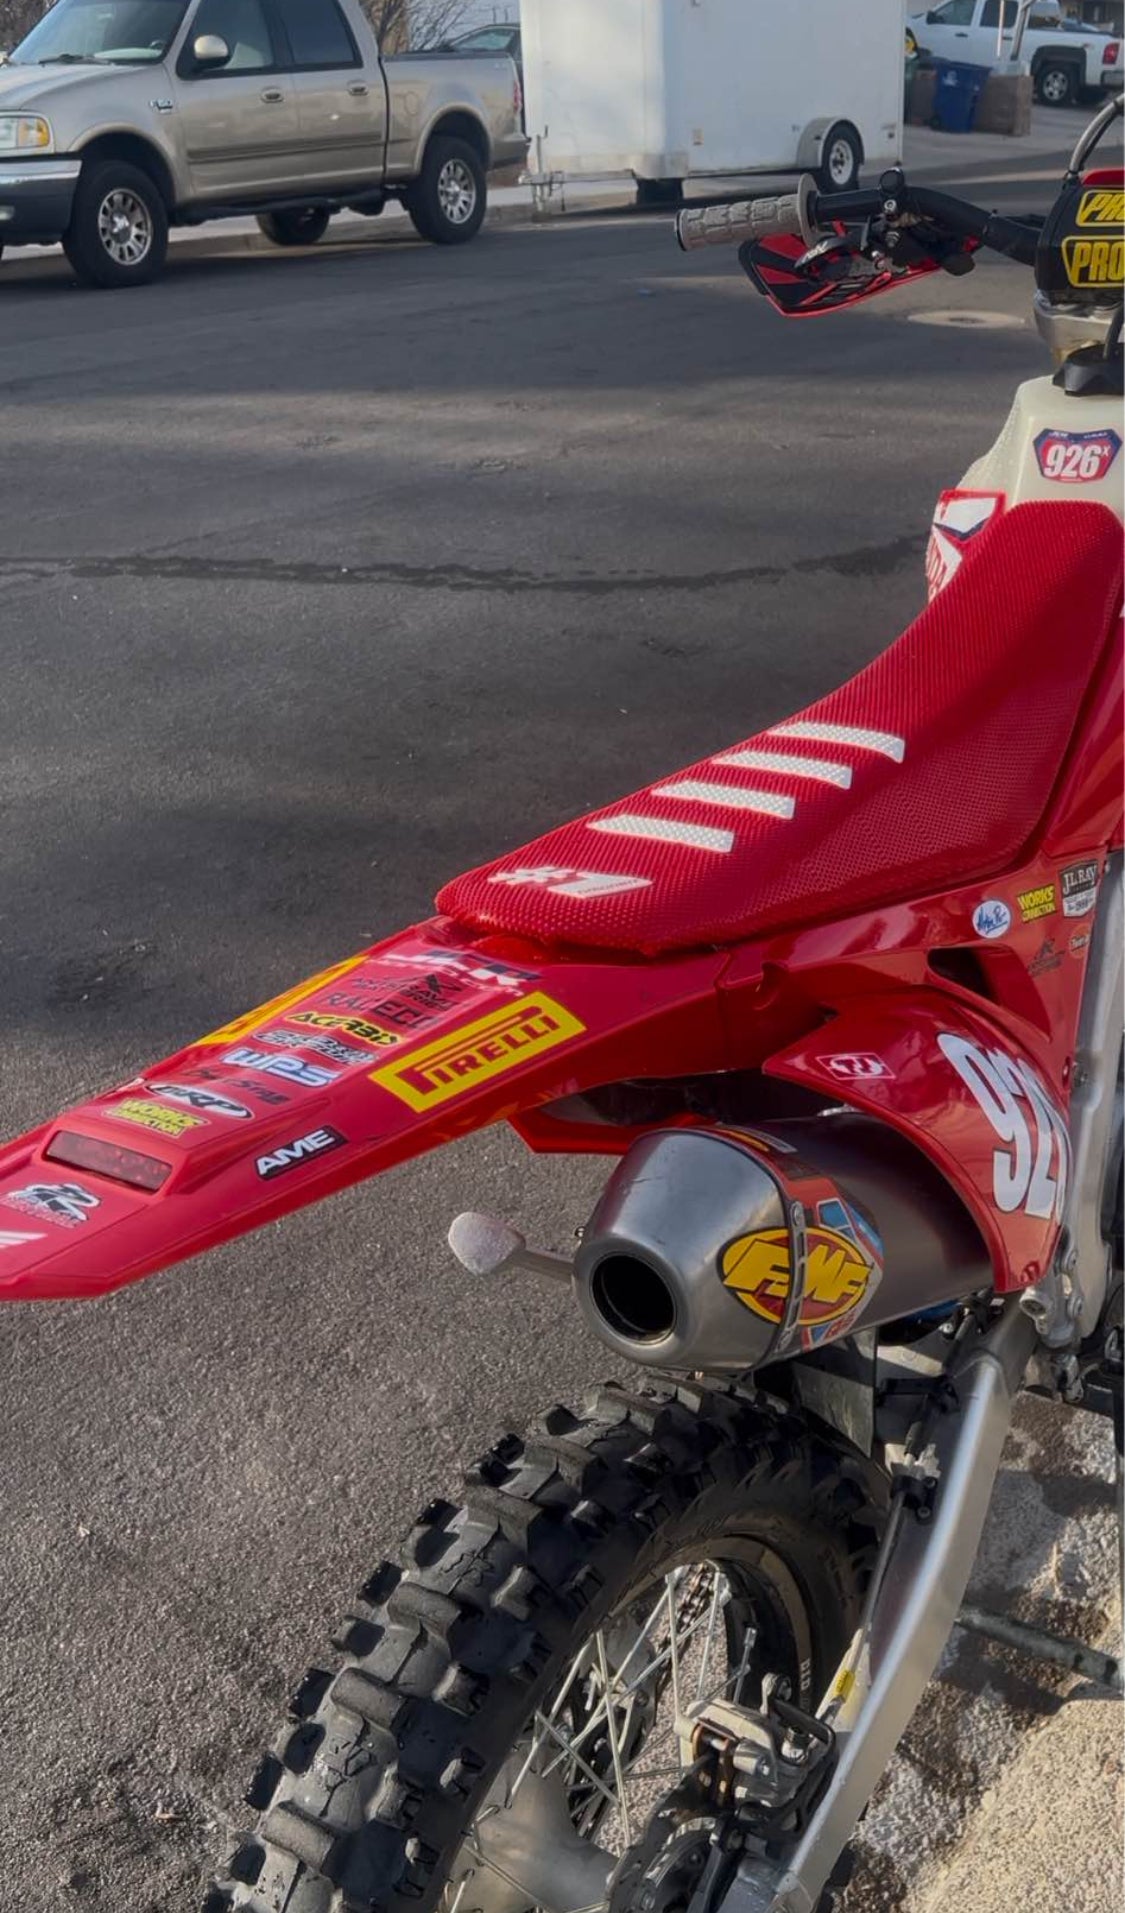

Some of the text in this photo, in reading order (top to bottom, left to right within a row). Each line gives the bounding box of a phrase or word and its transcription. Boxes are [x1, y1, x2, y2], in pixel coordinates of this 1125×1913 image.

[1070, 241, 1125, 284] PRO
[1043, 444, 1102, 478] 926
[1017, 885, 1054, 911] WORKS
[395, 1005, 560, 1096] PIRELLI
[257, 1129, 335, 1176] AME
[723, 1239, 873, 1304] FMF
